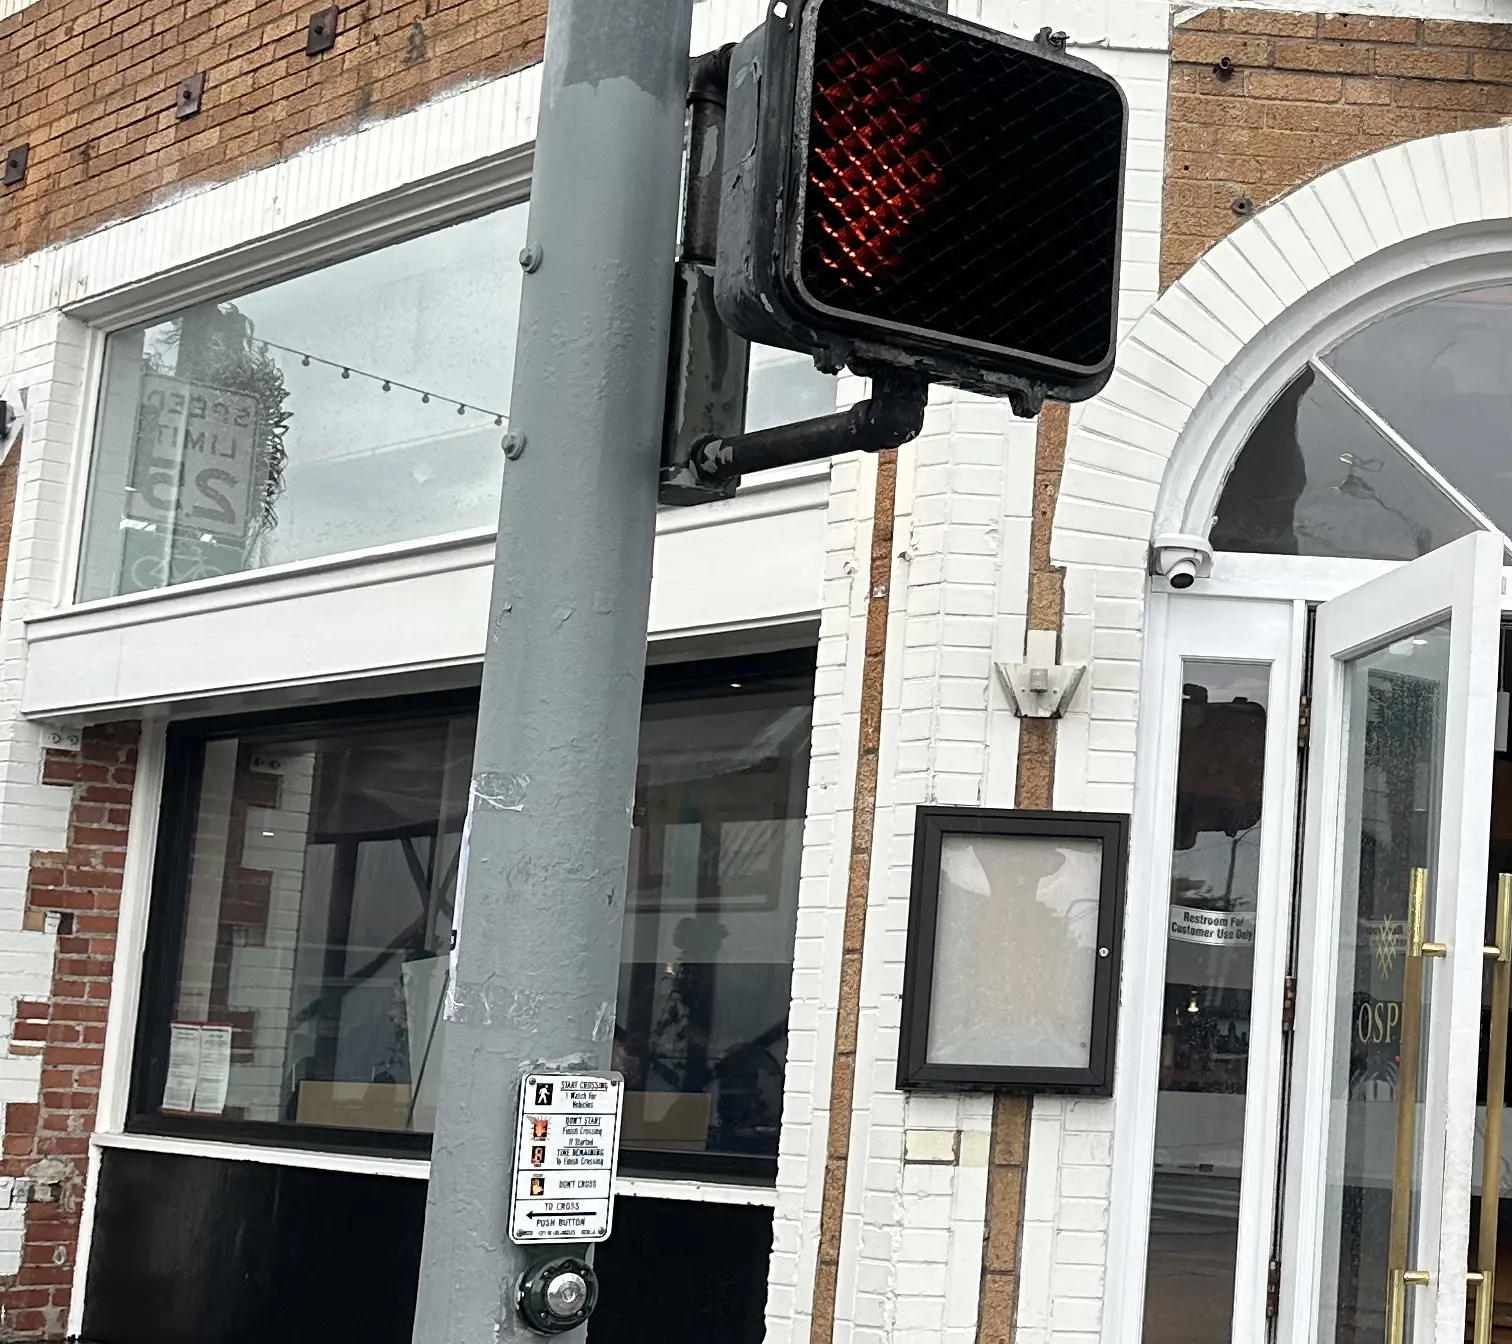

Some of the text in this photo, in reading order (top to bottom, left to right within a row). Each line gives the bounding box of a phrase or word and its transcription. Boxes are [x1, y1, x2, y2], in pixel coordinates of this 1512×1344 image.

[1184, 911, 1244, 927] Restroom For
[1172, 921, 1252, 942] Customer Use Only
[545, 1202, 579, 1211] TO CROSS
[536, 1218, 585, 1227] PUSH BUTTON
